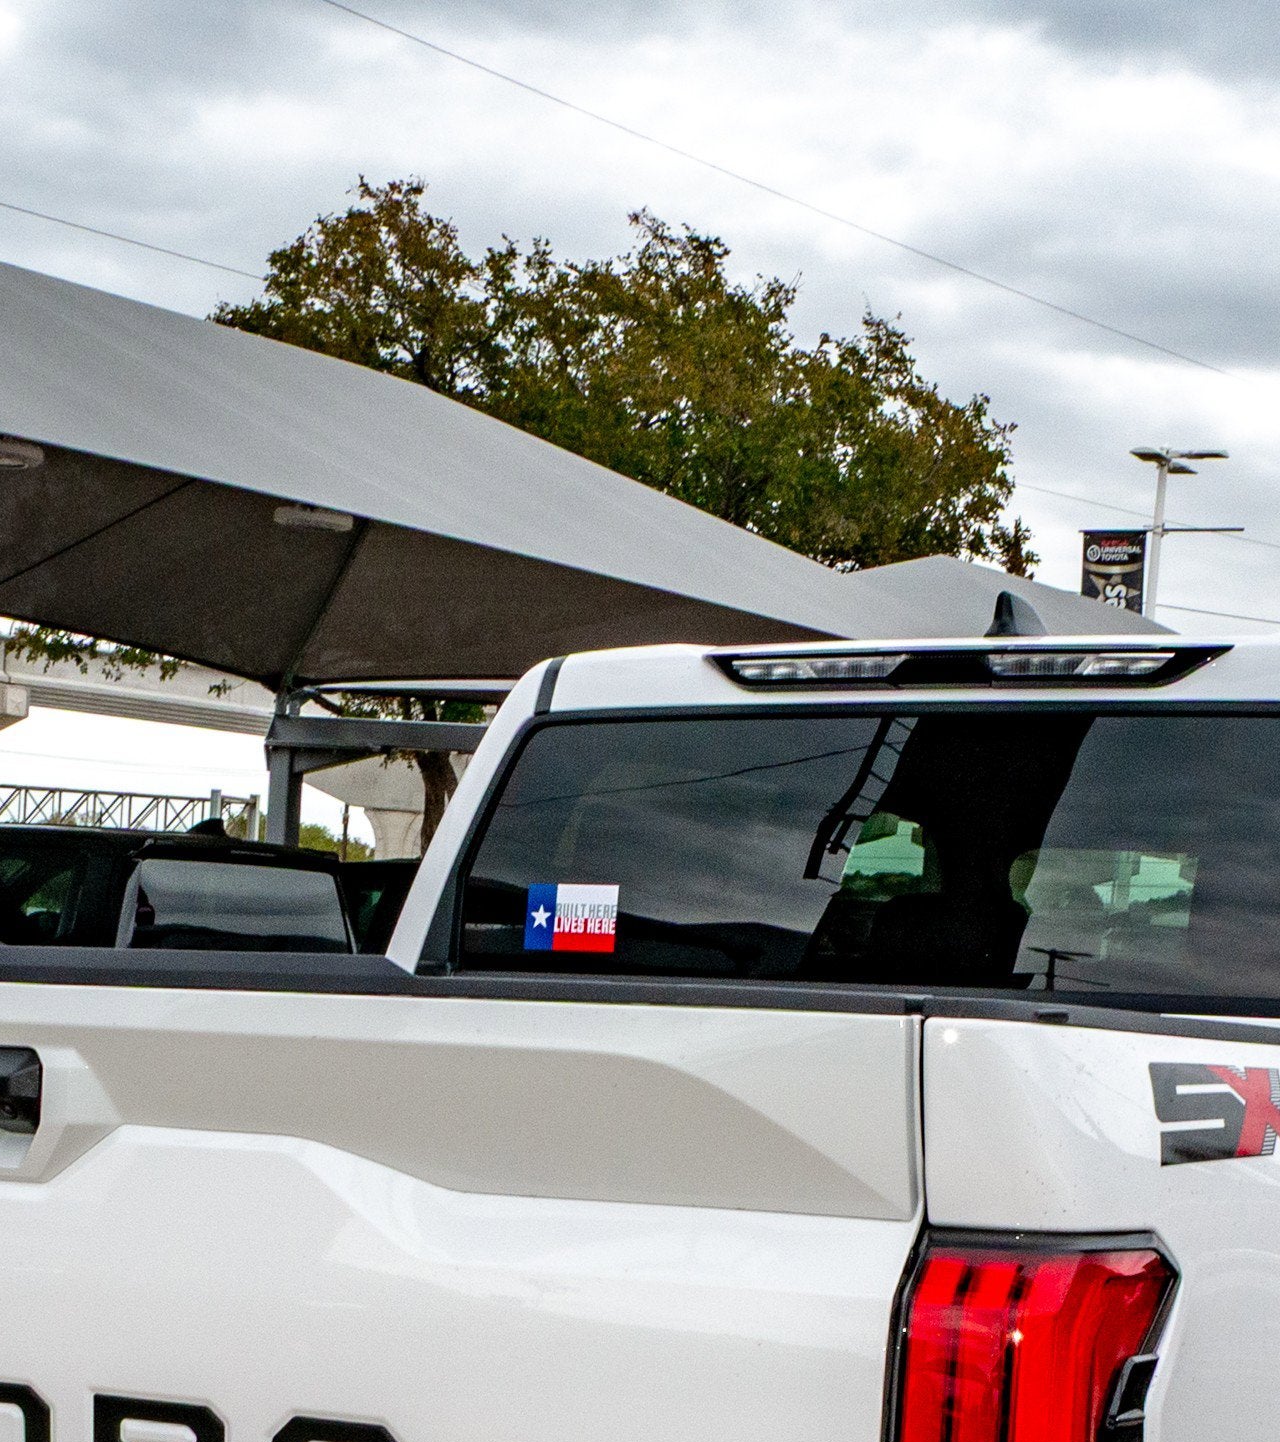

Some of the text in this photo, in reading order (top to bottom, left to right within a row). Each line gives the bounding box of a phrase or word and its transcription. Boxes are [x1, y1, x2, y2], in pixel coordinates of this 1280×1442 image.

[556, 903, 618, 918] BUILT HERE
[554, 916, 616, 935] LIVES HERE
